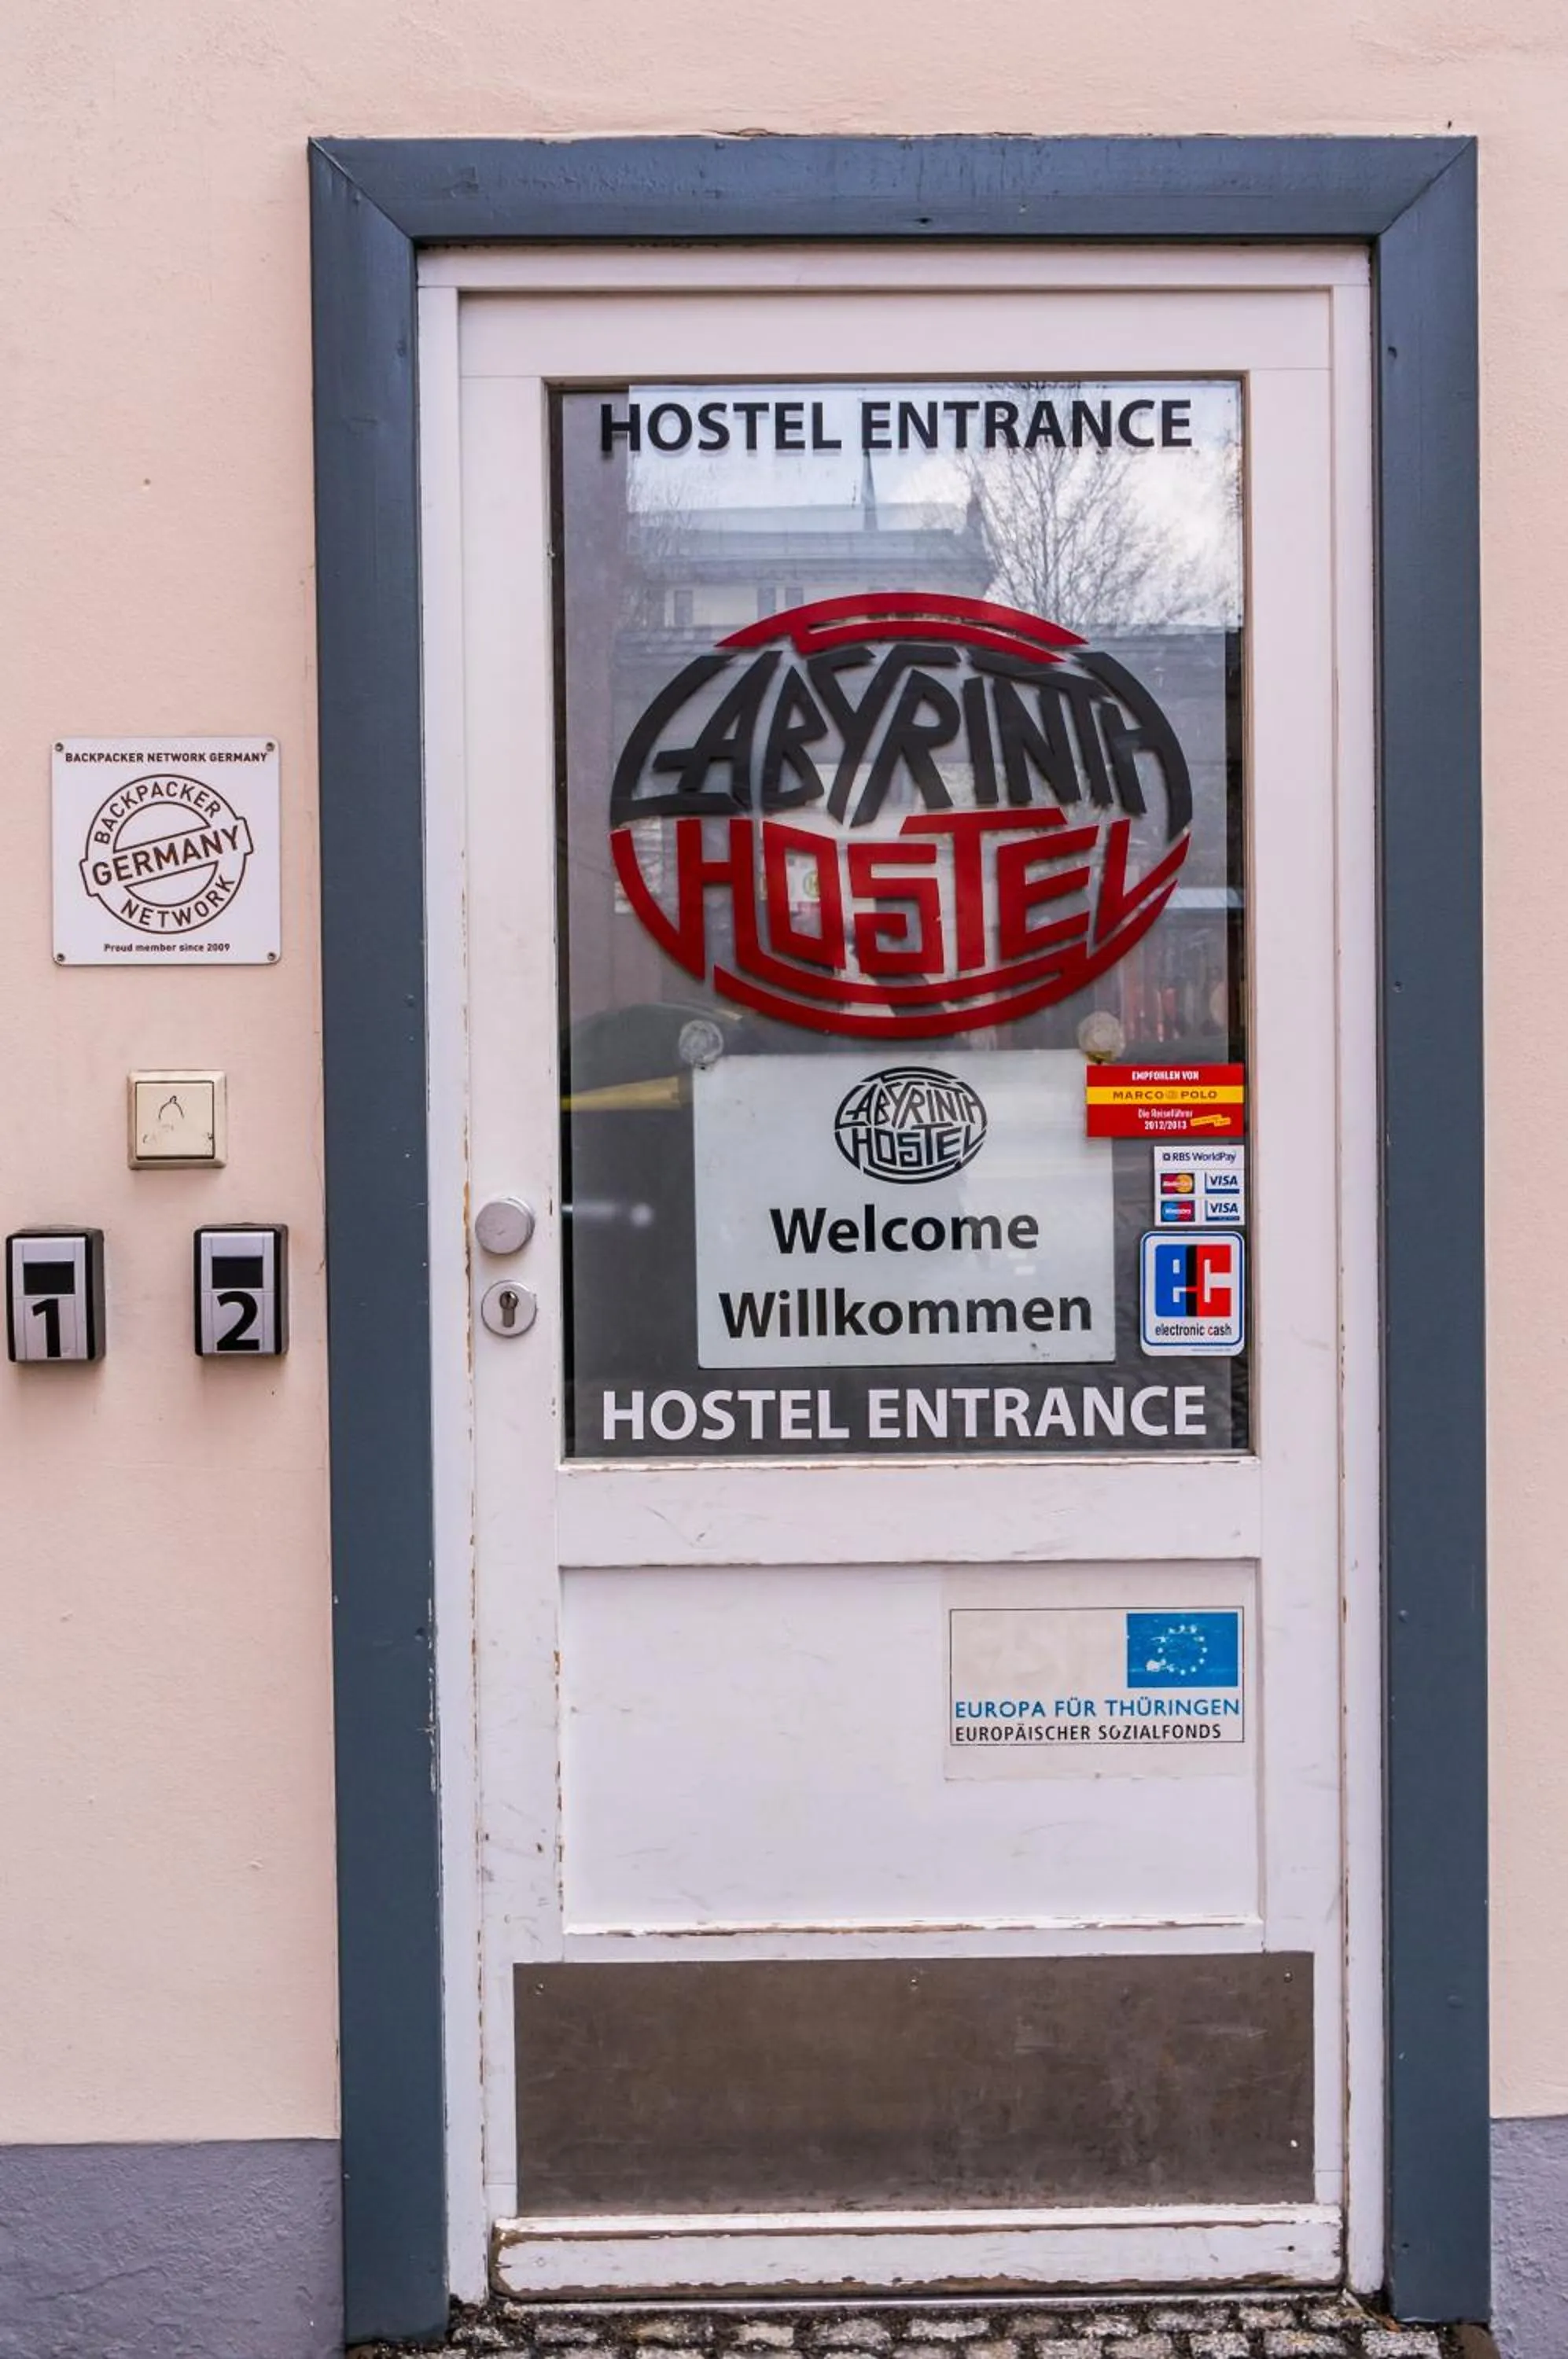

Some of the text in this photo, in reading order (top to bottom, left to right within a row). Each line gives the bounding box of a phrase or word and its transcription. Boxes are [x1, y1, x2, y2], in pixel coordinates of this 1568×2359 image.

[601, 399, 1193, 451] HOSTEL ENTRANCE
[64, 752, 268, 763] BACKPACKER NETWORK GERMANY
[609, 643, 1193, 844] LABYRINTH
[94, 780, 222, 845] BACKPACKER
[92, 825, 238, 887] GERMANY
[120, 875, 235, 928] NETWORK
[609, 807, 1191, 1008] HOSTEL
[103, 943, 230, 953] Proud member since 2009
[1112, 1090, 1218, 1100] MARCO POLO
[1181, 1070, 1200, 1081] VON
[834, 1080, 988, 1131] LABYRINTH
[834, 1122, 987, 1175] HOSTEL
[1172, 1151, 1237, 1164] RBS WorldPay
[1209, 1175, 1239, 1186] VISA
[769, 1203, 1040, 1255] Welcome
[1209, 1202, 1239, 1213] VISA
[31, 1297, 62, 1359] 1
[216, 1290, 260, 1352] 2
[717, 1287, 1093, 1339] Willkommen
[1154, 1322, 1232, 1337] electronic cash
[602, 1386, 1207, 1441] HOSTEL ENTRANCE
[955, 1696, 1240, 1718] EUROPA FÜR THÜRINGEN
[955, 1723, 1222, 1743] EUROPÄISCHER SOZIALFONDS
